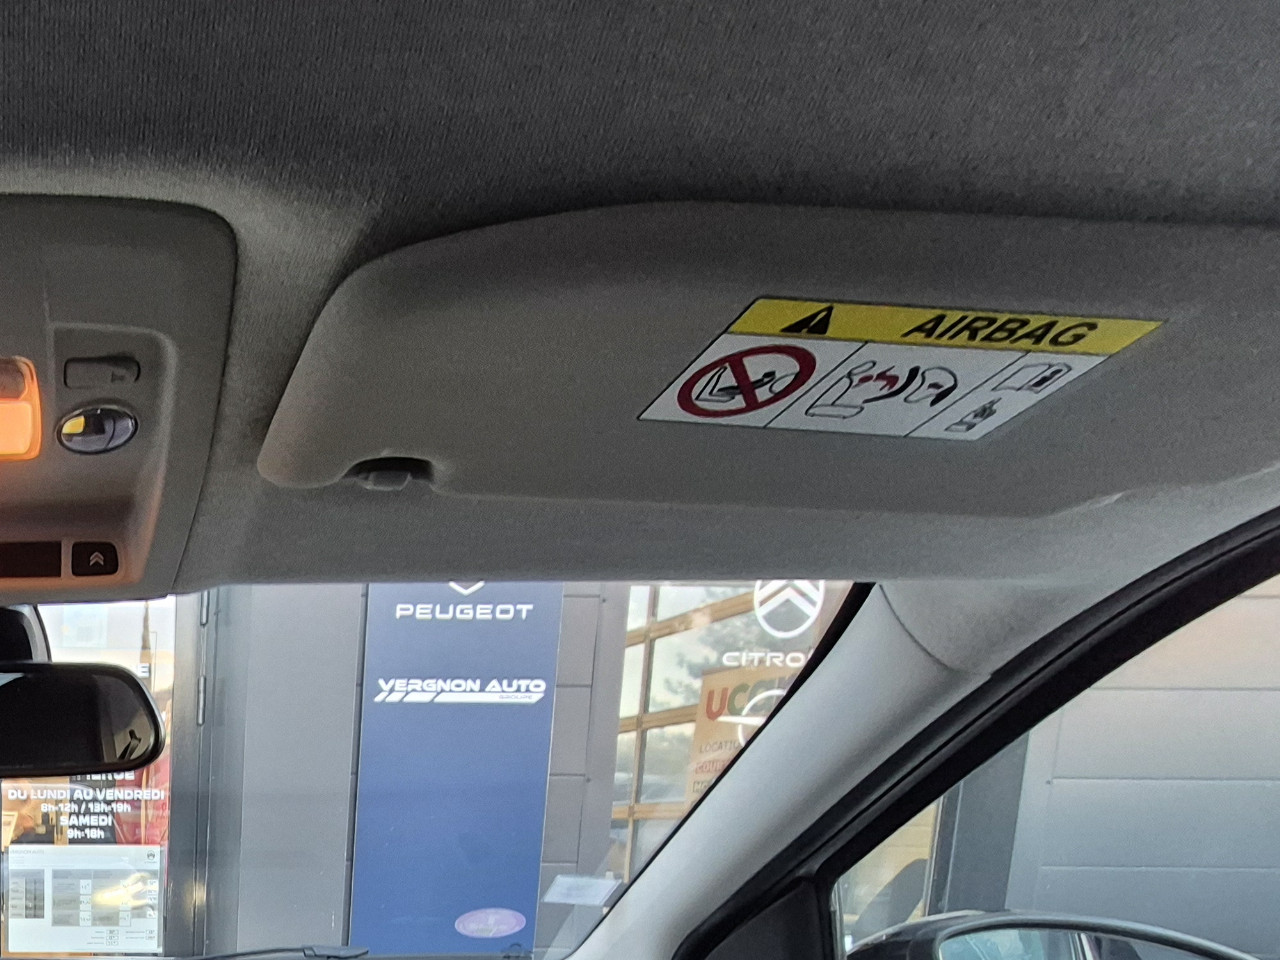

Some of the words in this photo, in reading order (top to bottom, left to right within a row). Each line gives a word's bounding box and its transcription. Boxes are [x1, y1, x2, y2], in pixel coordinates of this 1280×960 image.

[901, 314, 1099, 348] AIRBAG
[395, 603, 534, 620] PEUGEOT
[377, 677, 481, 692] VERGNON
[484, 677, 547, 693] AUTO
[8, 789, 27, 800] DU
[30, 789, 70, 800] LUNDI
[73, 789, 93, 800] AU
[96, 789, 165, 800] VENDREDI
[59, 815, 113, 826] SAMEDI
